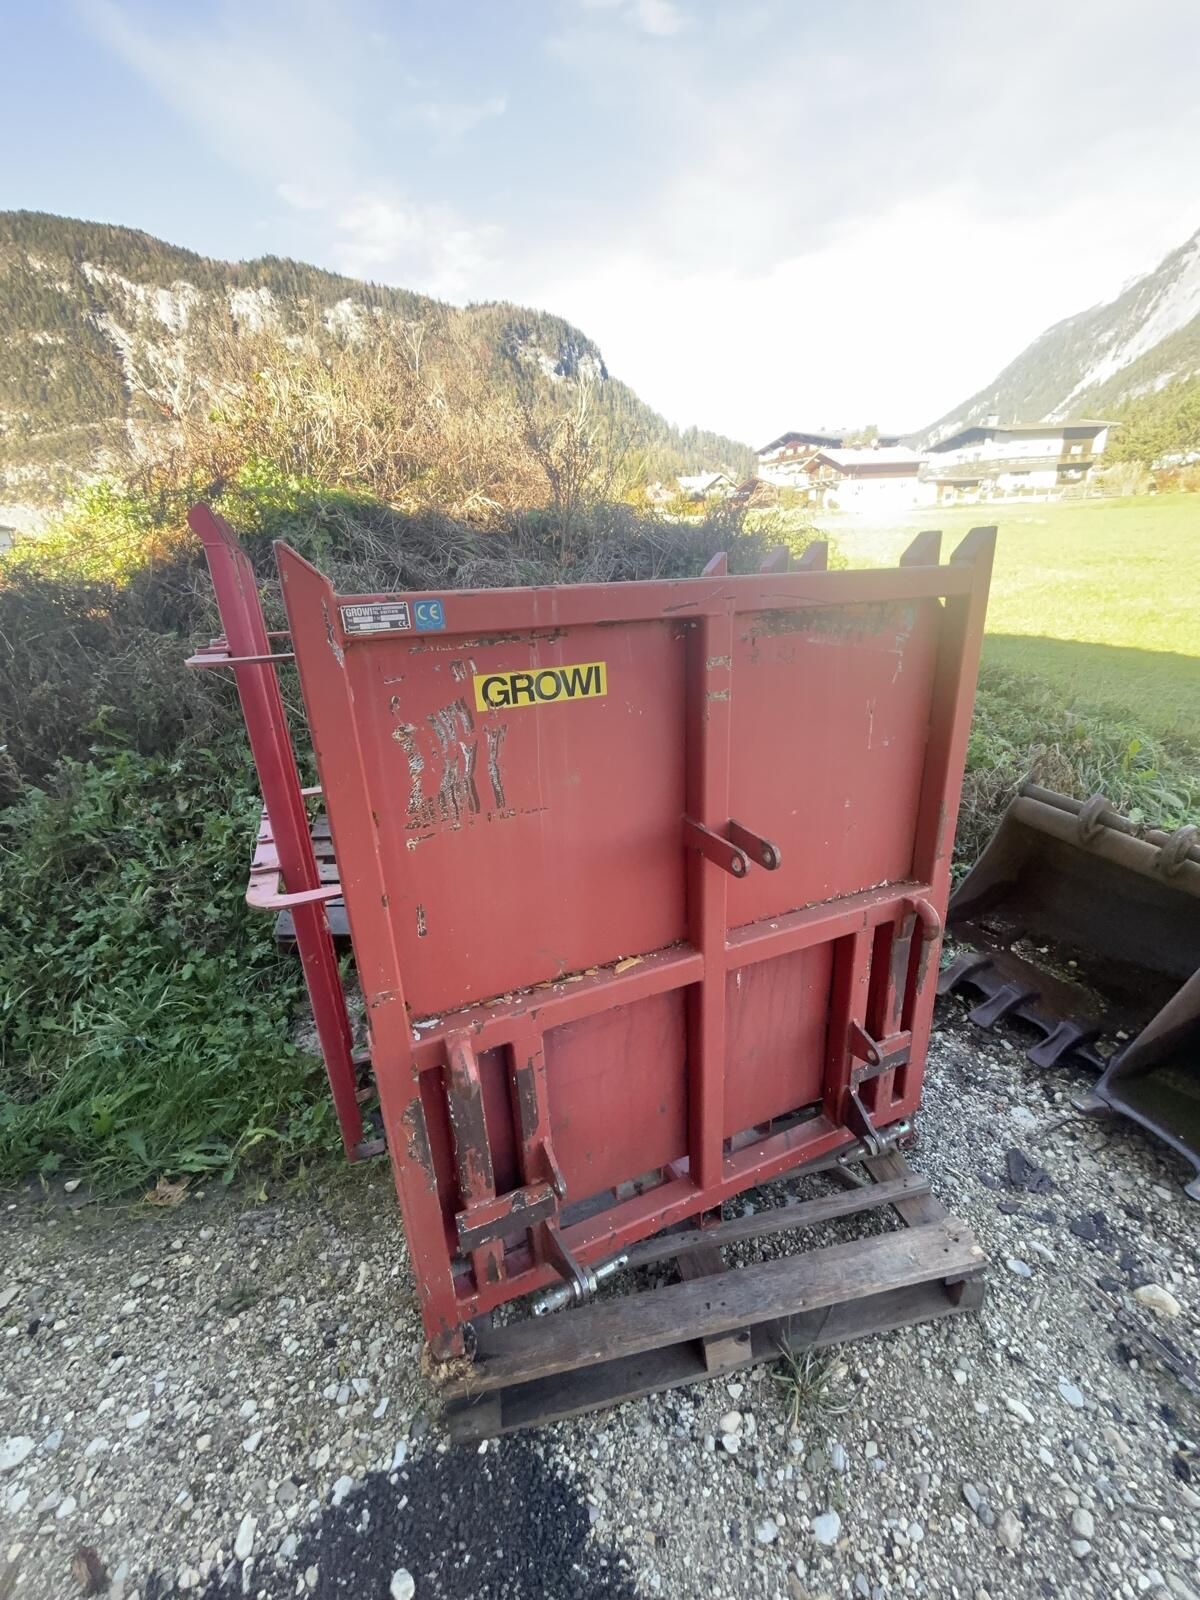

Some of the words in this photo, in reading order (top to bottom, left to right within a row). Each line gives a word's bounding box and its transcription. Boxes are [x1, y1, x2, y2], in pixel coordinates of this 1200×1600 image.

[345, 607, 373, 617] GROWI
[417, 603, 440, 621] CE
[481, 665, 602, 708] GROWI
